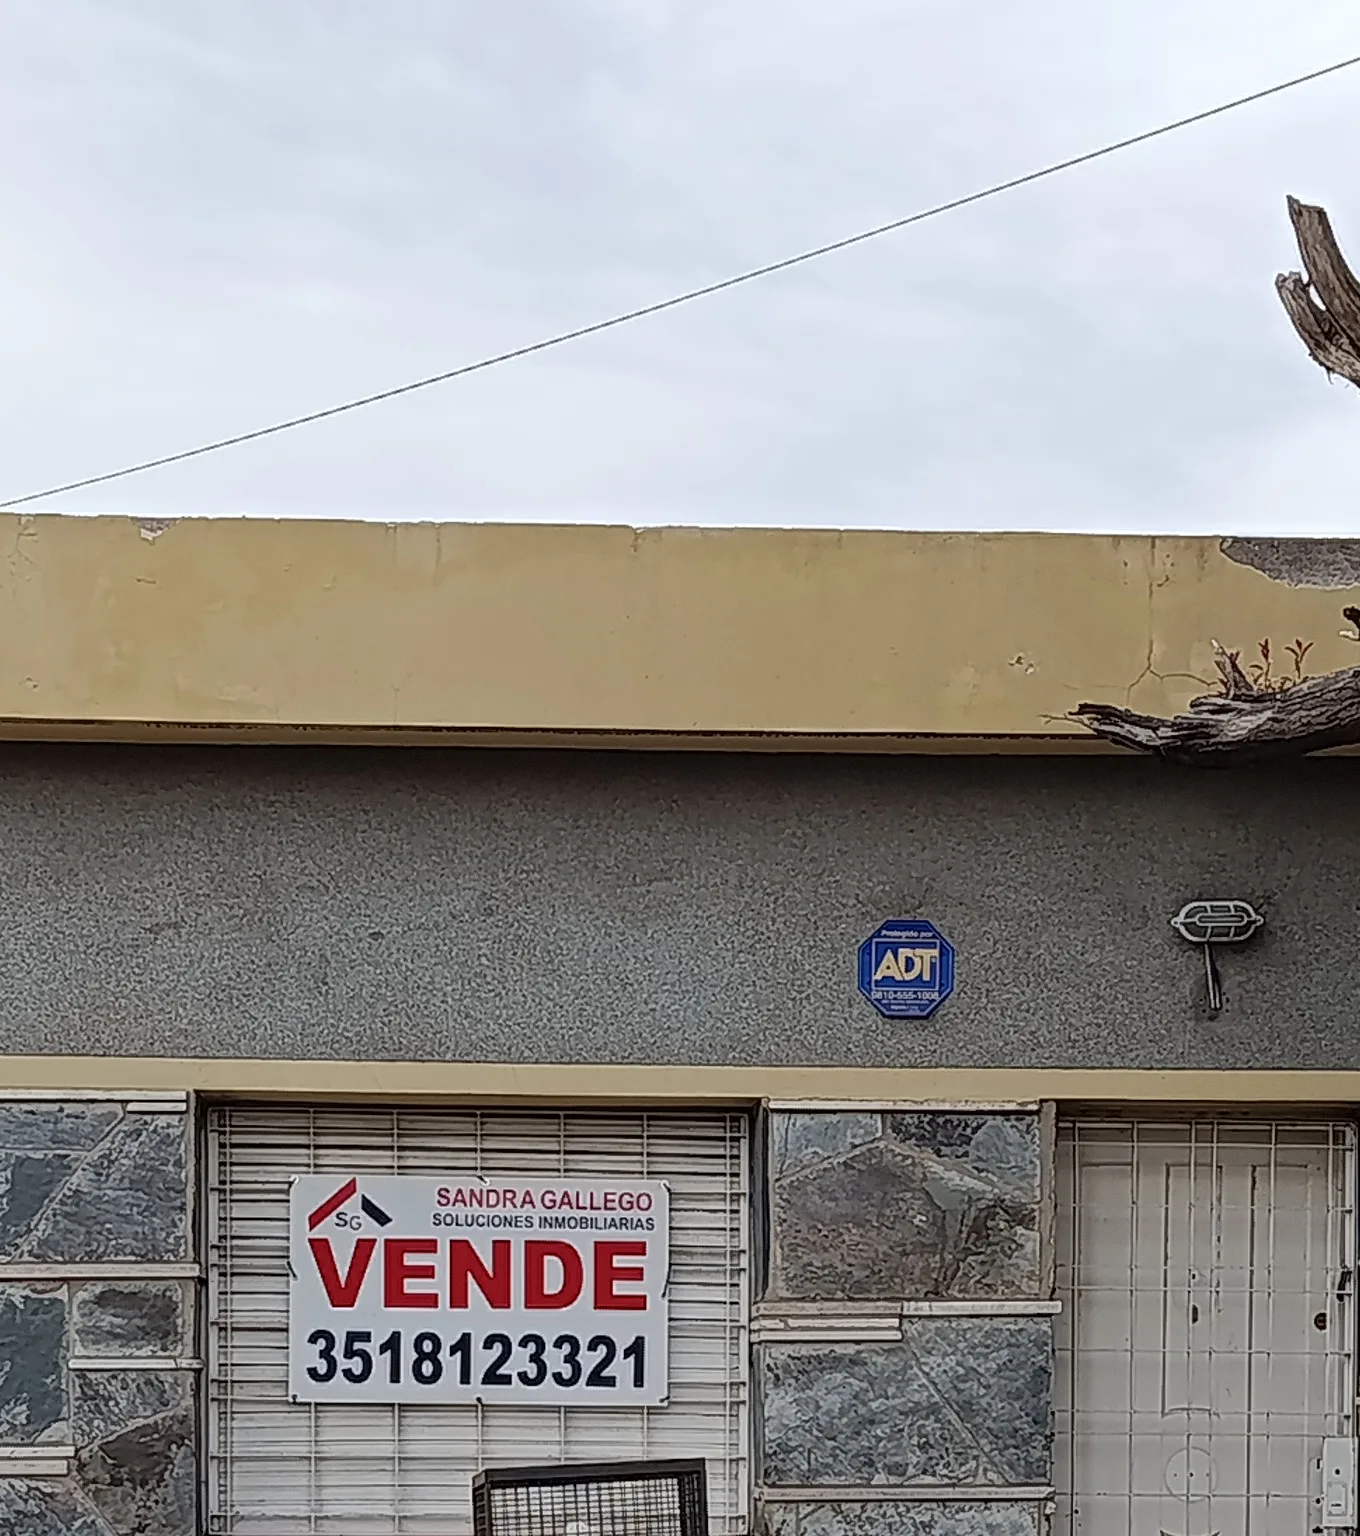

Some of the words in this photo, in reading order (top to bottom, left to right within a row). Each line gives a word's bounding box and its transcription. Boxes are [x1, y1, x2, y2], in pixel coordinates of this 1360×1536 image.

[874, 948, 939, 981] ADT
[437, 1187, 536, 1209] SANDRA
[540, 1190, 653, 1211] GALLEGO
[334, 1211, 363, 1231] SG
[432, 1213, 534, 1229] SOLUCIONES
[538, 1215, 655, 1231] INMOBILIARIAS
[307, 1237, 647, 1311] VENDE
[306, 1329, 646, 1388] 3518123321
